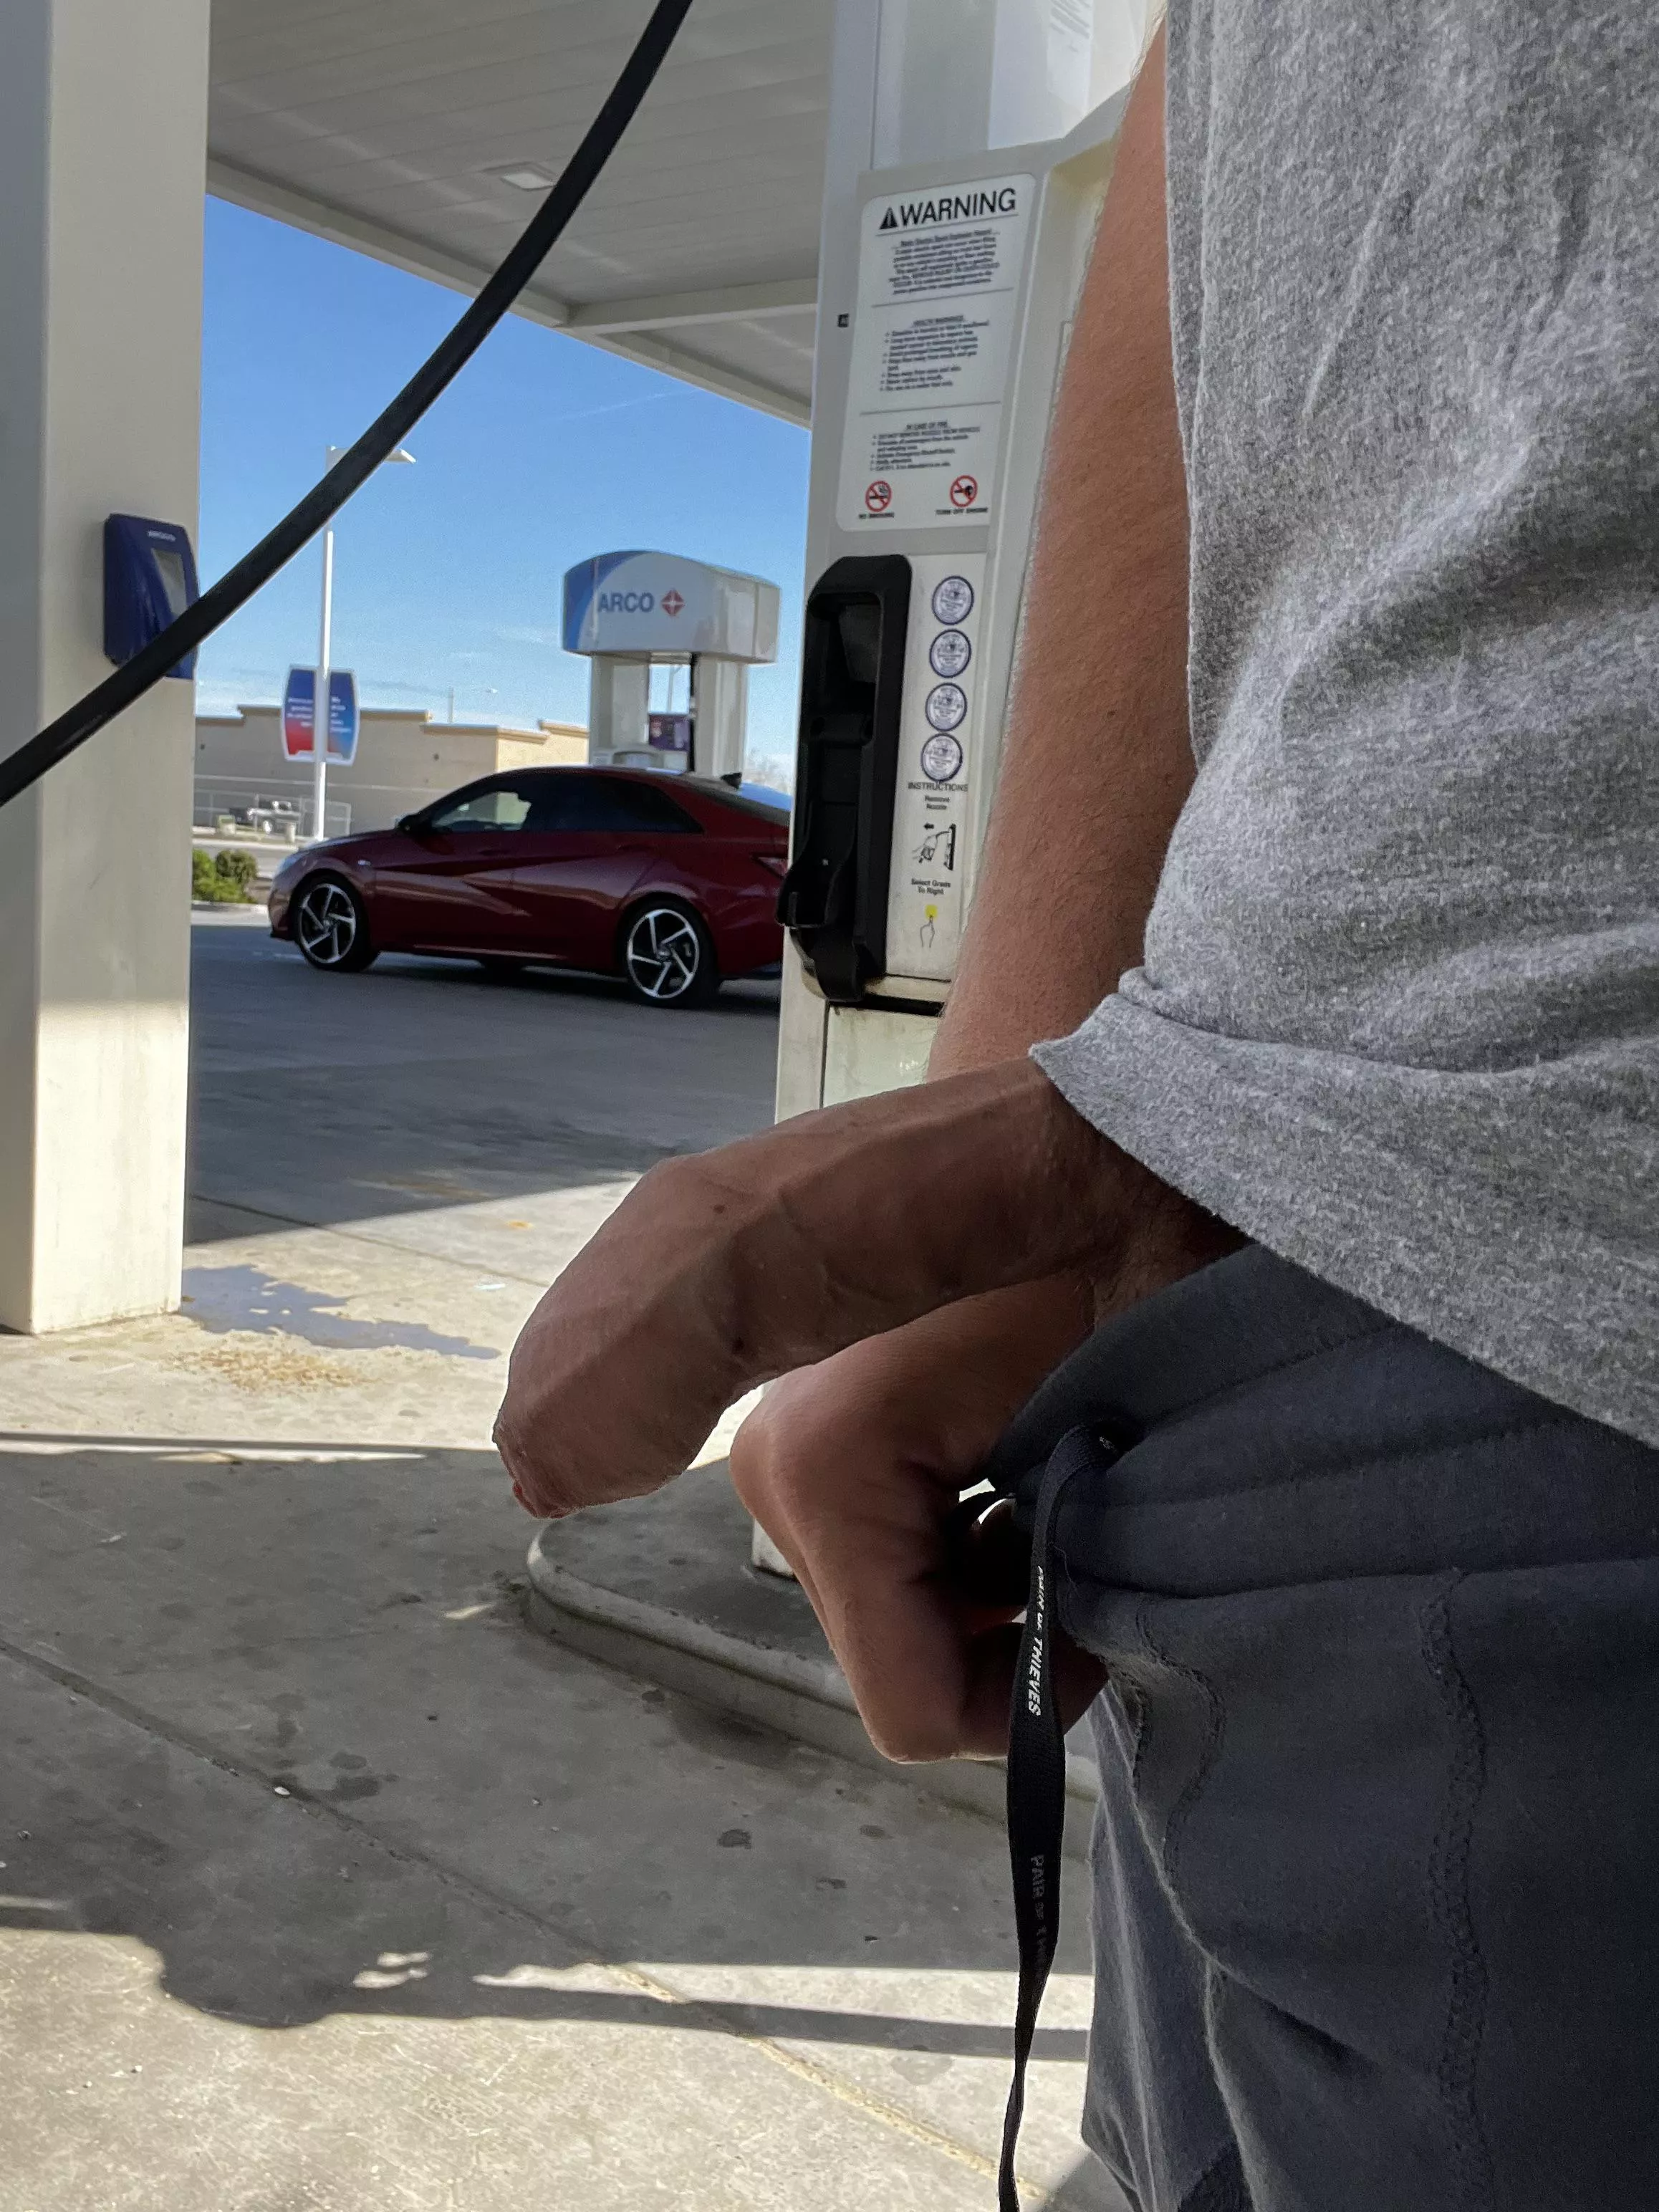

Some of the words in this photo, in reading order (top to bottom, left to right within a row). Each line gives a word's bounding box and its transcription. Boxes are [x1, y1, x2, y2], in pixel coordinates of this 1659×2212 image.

[900, 188, 1016, 226] WARNING
[598, 592, 655, 613] ARCO
[908, 782, 968, 792] INSTRUCTIONS
[1028, 1636, 1044, 1716] THIEVES
